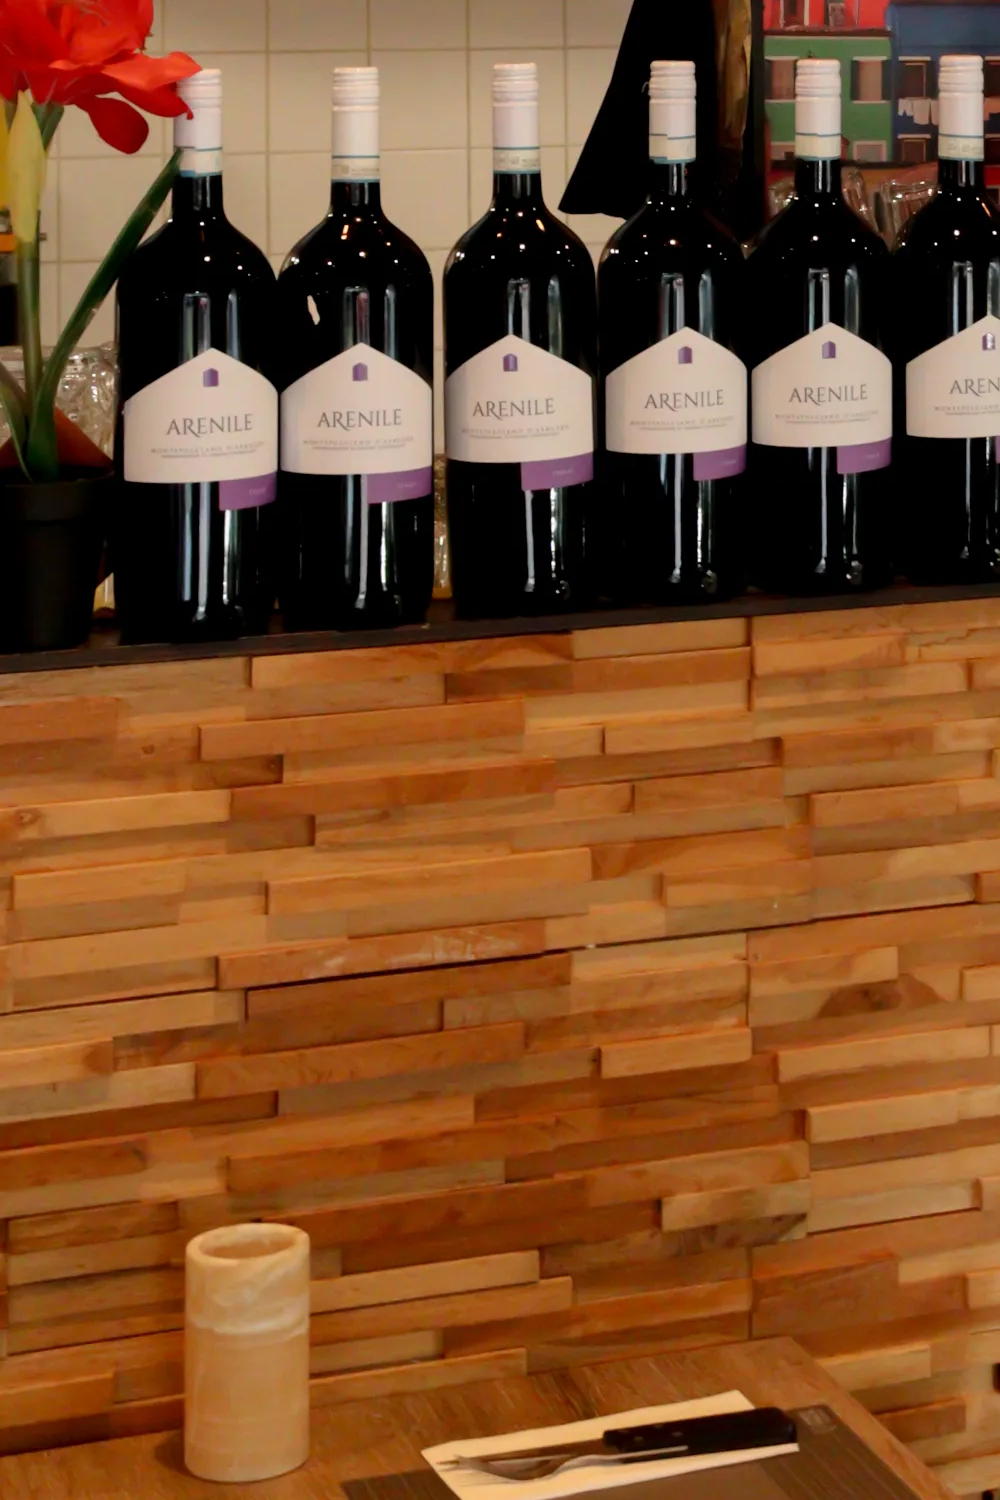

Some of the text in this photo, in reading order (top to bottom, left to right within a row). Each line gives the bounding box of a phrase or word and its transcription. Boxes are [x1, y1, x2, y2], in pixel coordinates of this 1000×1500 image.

[644, 389, 724, 412] ARENILE
[788, 383, 868, 406] ARENILE
[316, 408, 403, 432] ARENILE
[472, 398, 556, 421] ARENILE
[166, 414, 254, 438] ARENILE
